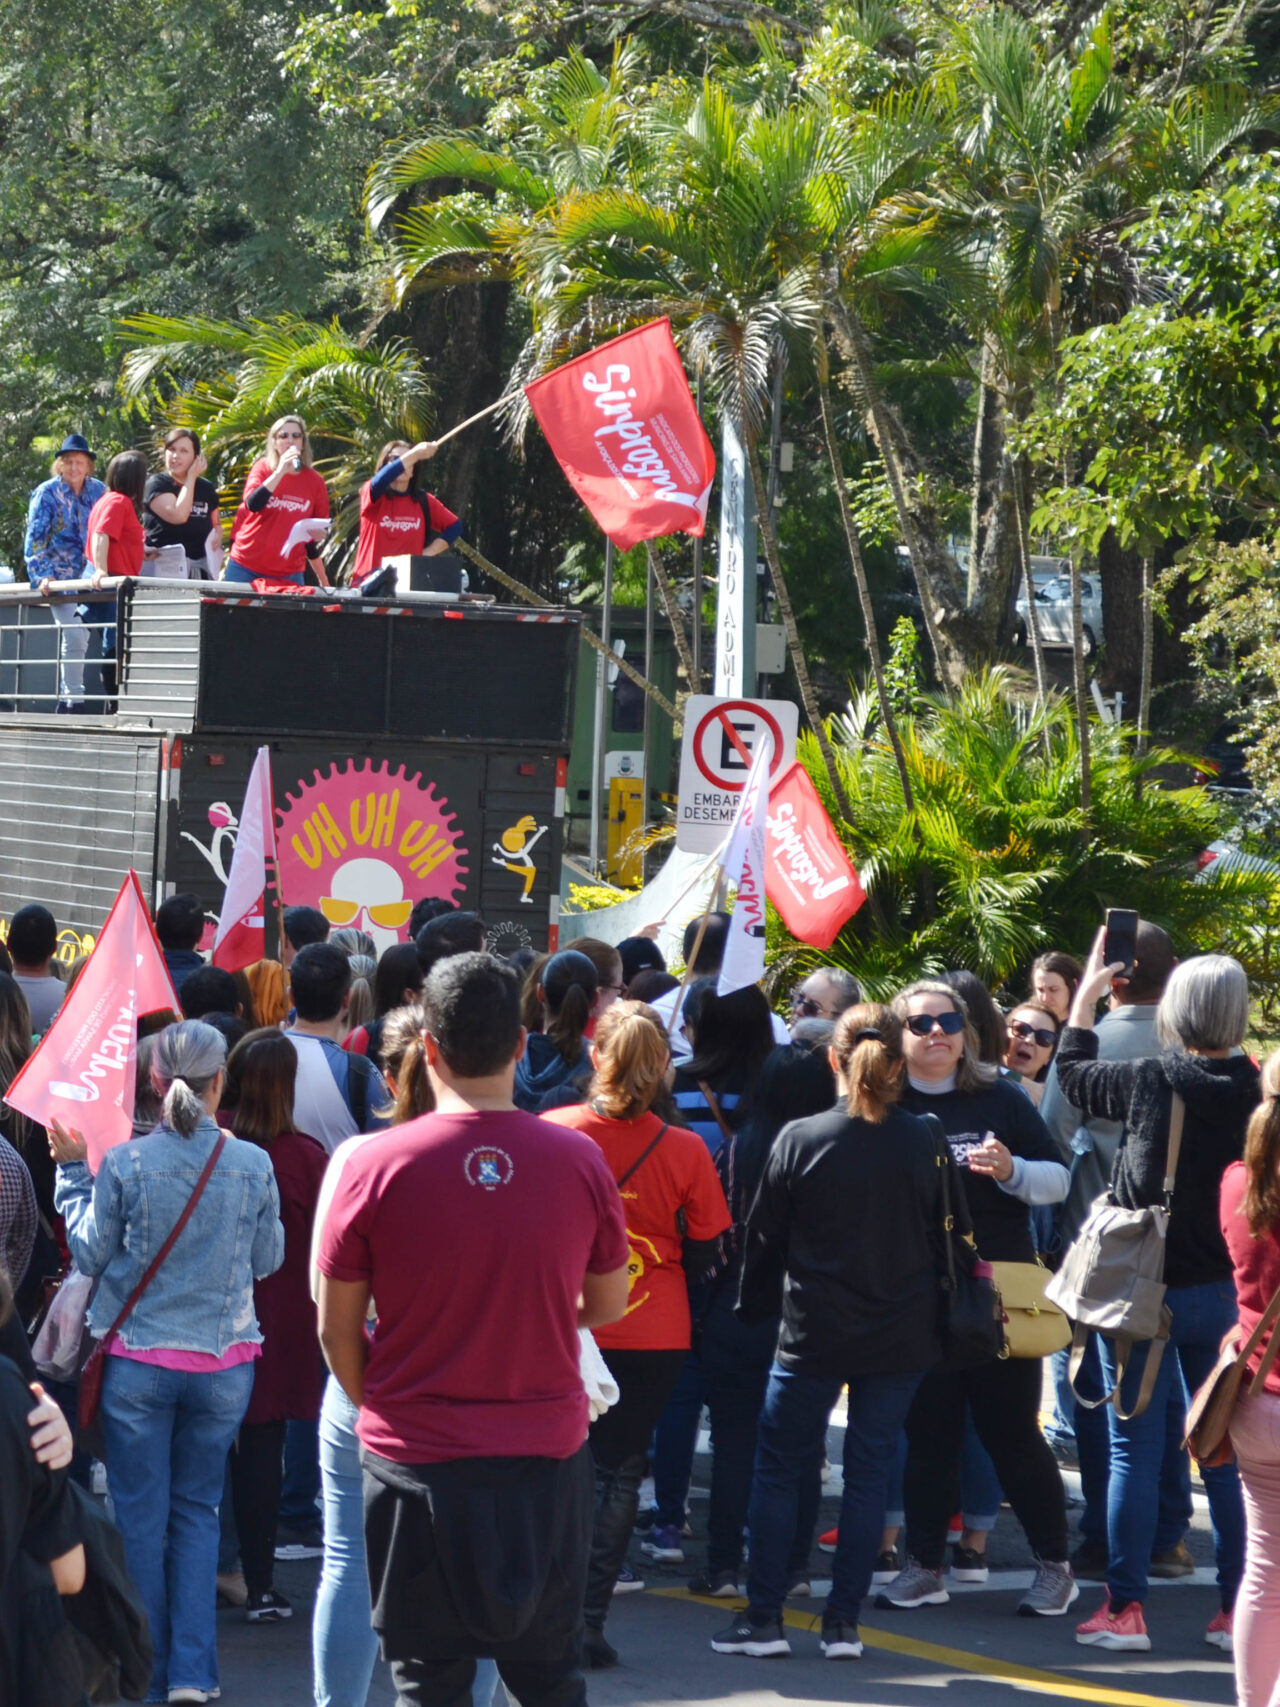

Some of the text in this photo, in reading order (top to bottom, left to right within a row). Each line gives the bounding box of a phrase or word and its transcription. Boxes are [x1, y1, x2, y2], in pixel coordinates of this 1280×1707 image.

[583, 363, 696, 508] Sinprosm
[723, 458, 738, 698] CENTRO ADMI
[291, 788, 456, 879] UH UH UH
[684, 806, 738, 821] DESEM
[694, 792, 741, 807] EMBAR
